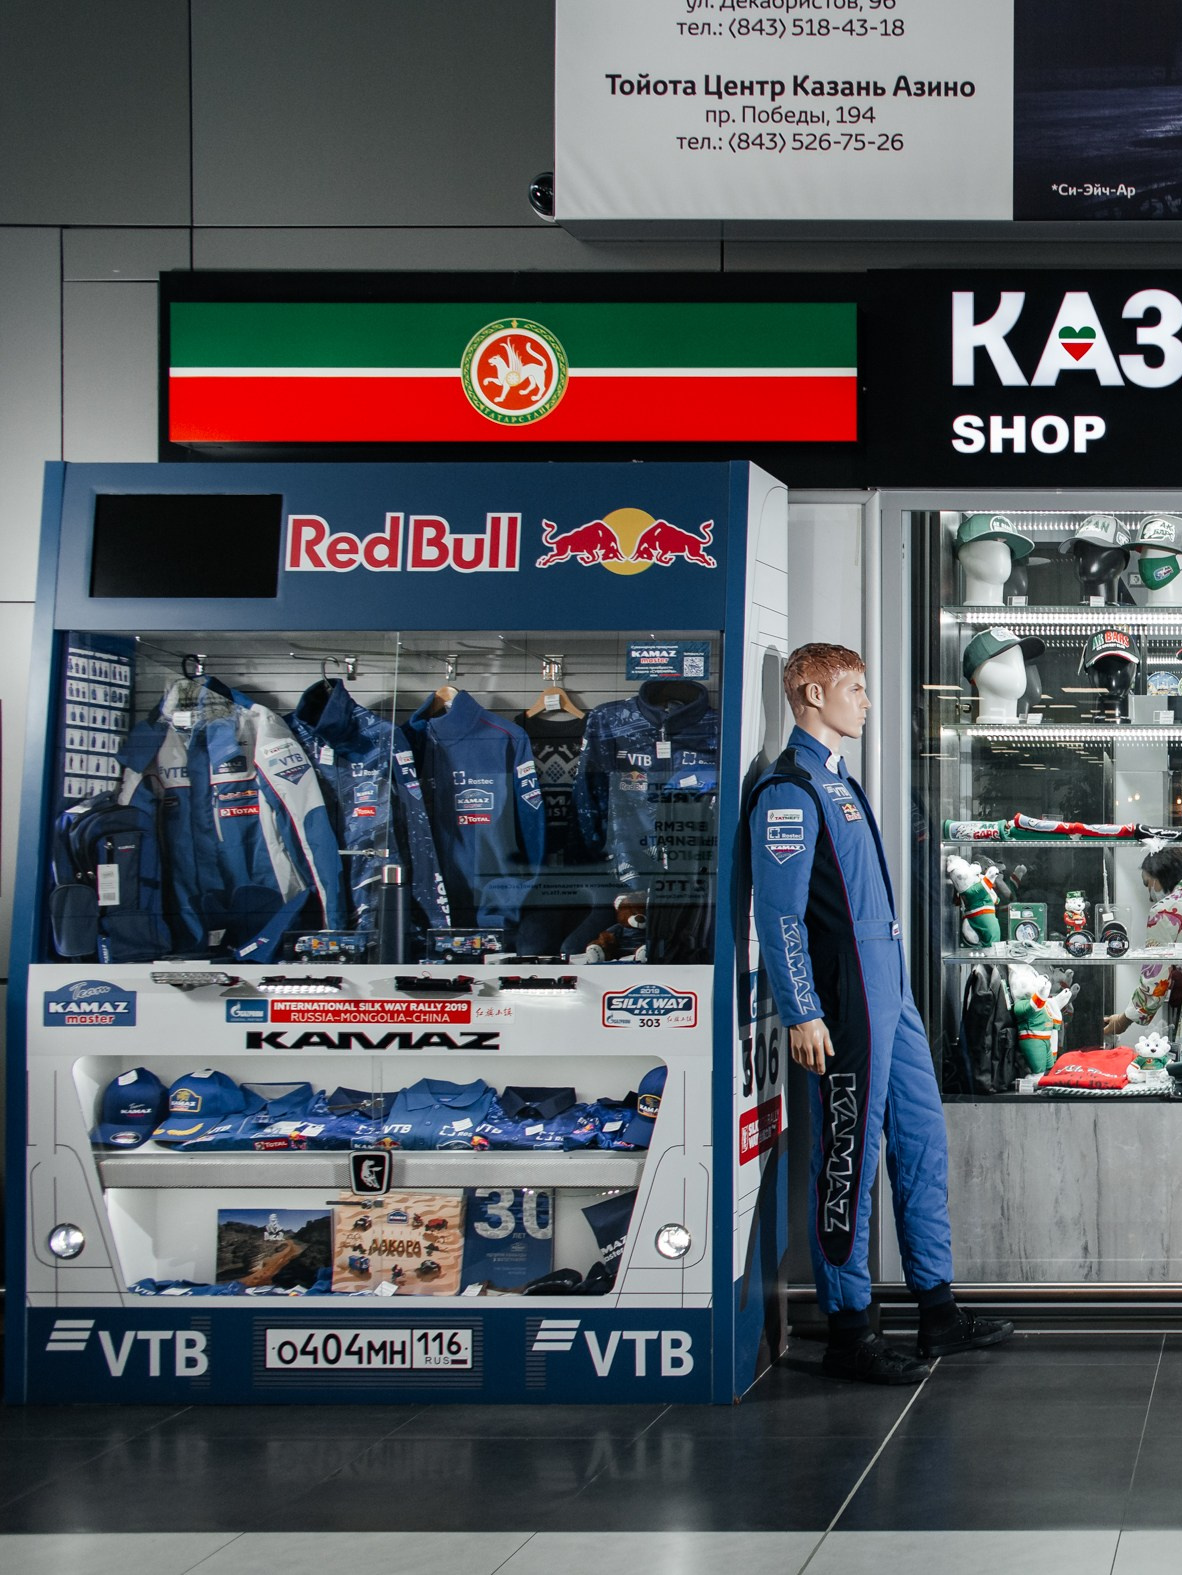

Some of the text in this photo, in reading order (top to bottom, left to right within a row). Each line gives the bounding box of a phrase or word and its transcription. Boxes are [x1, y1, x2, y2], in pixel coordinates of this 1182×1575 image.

[677, 22, 723, 36] тел.:
[791, 18, 905, 37] 518-43-18
[605, 73, 976, 101] Тойота Центр Казань Азино
[705, 105, 876, 127] пр. Победы, 194
[676, 136, 723, 151] тел.:
[791, 133, 905, 151] 526-75-26
[951, 414, 1106, 454] SHOP
[1104, 630, 1130, 648] BARS
[279, 753, 304, 766] VTB
[627, 753, 653, 767] VTB
[162, 766, 189, 779] VTB
[973, 830, 1000, 840] БАРС
[779, 915, 817, 1016] KAMAZ
[69, 981, 112, 1001] Team
[49, 1002, 129, 1013] KAMAZ
[273, 1002, 468, 1012] INTERNATIONAL SILK WAY RALLY 2019
[610, 998, 690, 1009] SILK WAY
[65, 1013, 116, 1025] master
[639, 1018, 661, 1028] 303
[245, 1031, 500, 1050] KAMAZ
[383, 1124, 413, 1134] VTB
[264, 1140, 288, 1149] TOTAL
[823, 1072, 857, 1232] KAMAZ
[473, 1187, 554, 1240] 30
[416, 1331, 462, 1356] 116
[98, 1330, 209, 1377] VTB
[425, 1356, 450, 1365] RUS
[584, 1330, 694, 1377] VTB
